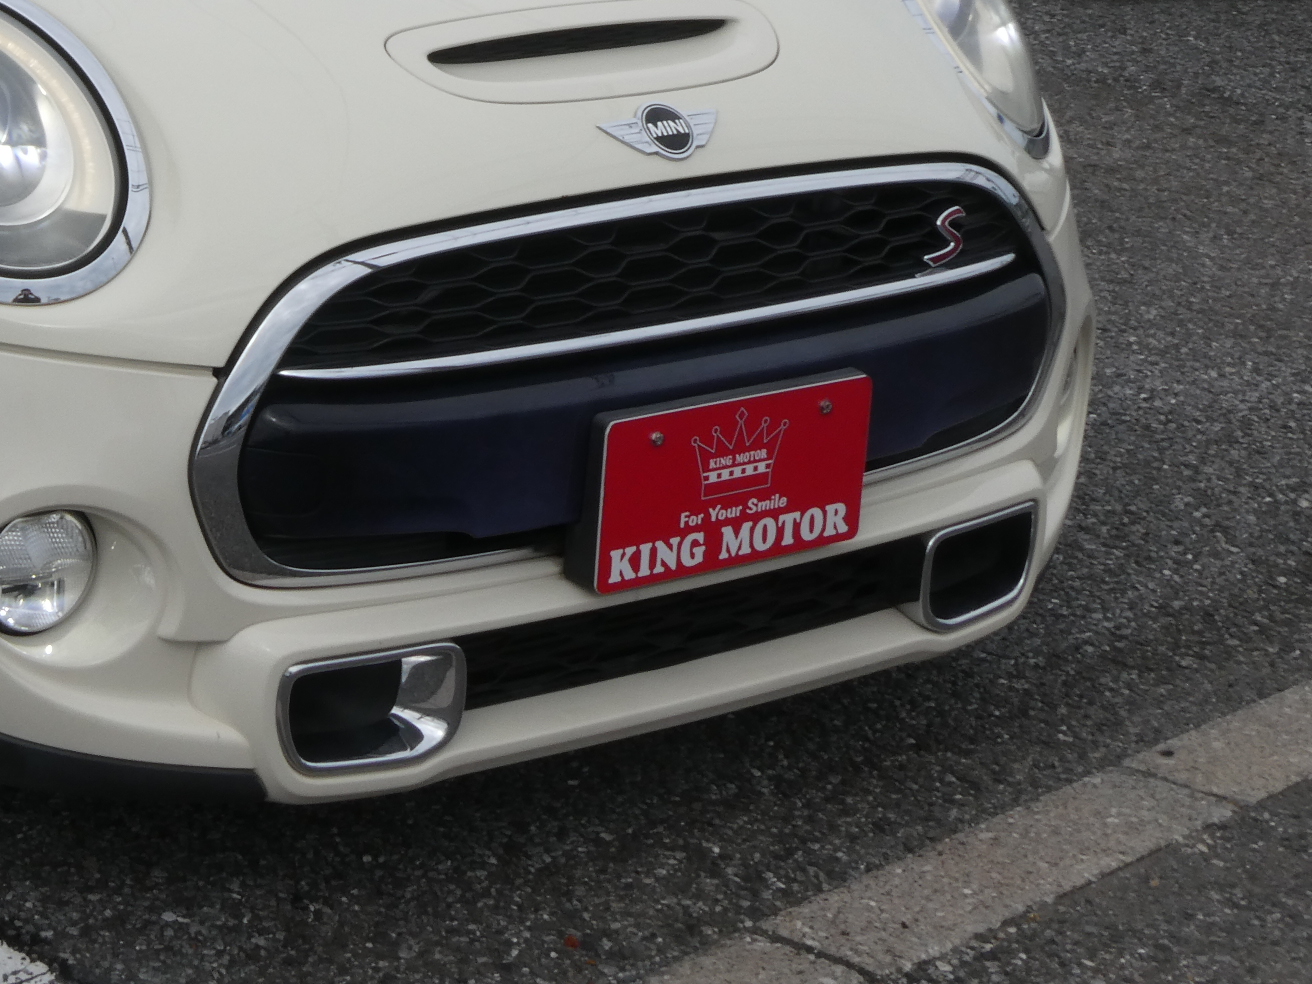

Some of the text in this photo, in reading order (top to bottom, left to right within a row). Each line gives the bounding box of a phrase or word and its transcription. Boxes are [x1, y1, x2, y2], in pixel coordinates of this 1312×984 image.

[647, 118, 689, 138] MINI
[924, 206, 966, 268] S
[709, 448, 768, 469] KING MOTOR
[680, 493, 787, 528] For Your Smile
[608, 502, 849, 584] KING MOTOR
